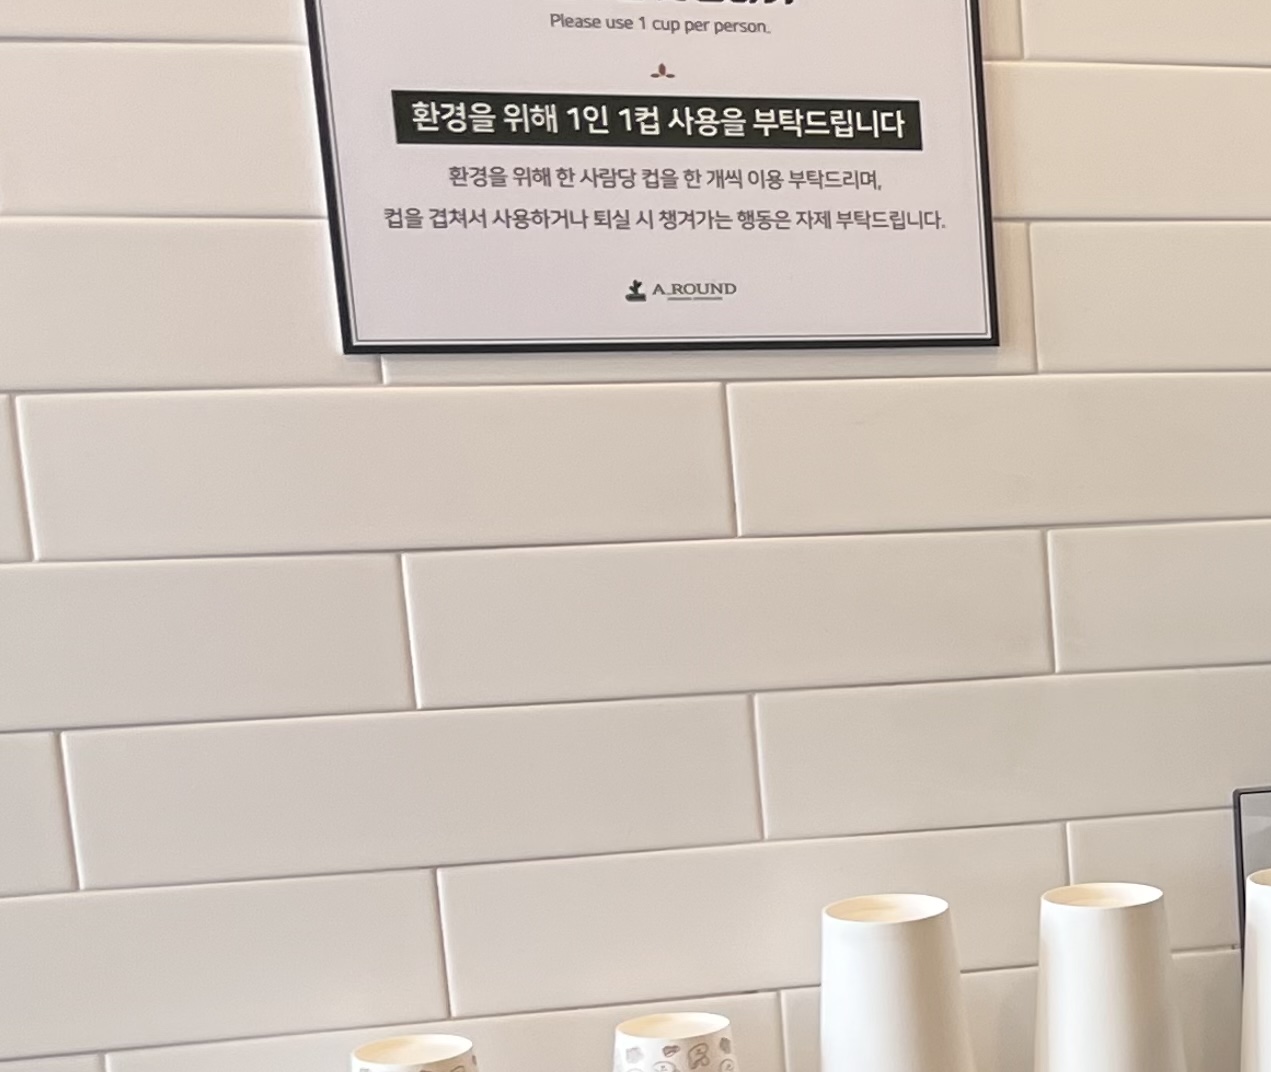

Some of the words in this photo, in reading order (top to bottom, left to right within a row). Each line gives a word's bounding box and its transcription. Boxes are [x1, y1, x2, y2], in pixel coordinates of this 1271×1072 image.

[550, 13, 601, 29] Please
[605, 18, 633, 29] use
[637, 17, 646, 29] 1
[652, 18, 680, 34] cup
[684, 20, 710, 34] per
[714, 20, 771, 34] person.
[412, 101, 496, 133] 환경을
[503, 103, 558, 134] 위해
[566, 105, 610, 135] 1인
[618, 106, 660, 135] 1컵
[668, 106, 746, 137] 사용을
[753, 108, 905, 139] 부탁드립니다
[449, 166, 508, 188] 환경을
[512, 167, 551, 188] 위해
[555, 167, 576, 188] 한
[580, 168, 637, 189] 사람당
[641, 168, 678, 189] 컵을
[683, 169, 702, 189] 한
[706, 169, 743, 190] 개씩
[748, 169, 784, 190] 이용
[788, 170, 882, 191] 부탁드리며,
[384, 207, 424, 229] 컵을
[428, 207, 487, 229] 겹쳐서
[492, 208, 589, 229] 사용하거나
[594, 208, 631, 230] 퇴실
[636, 209, 654, 230] 시
[658, 209, 733, 230] 챙겨가는
[737, 210, 791, 230] 행동은
[796, 210, 832, 230] 자제
[836, 210, 946, 230] 부탁드립니다.
